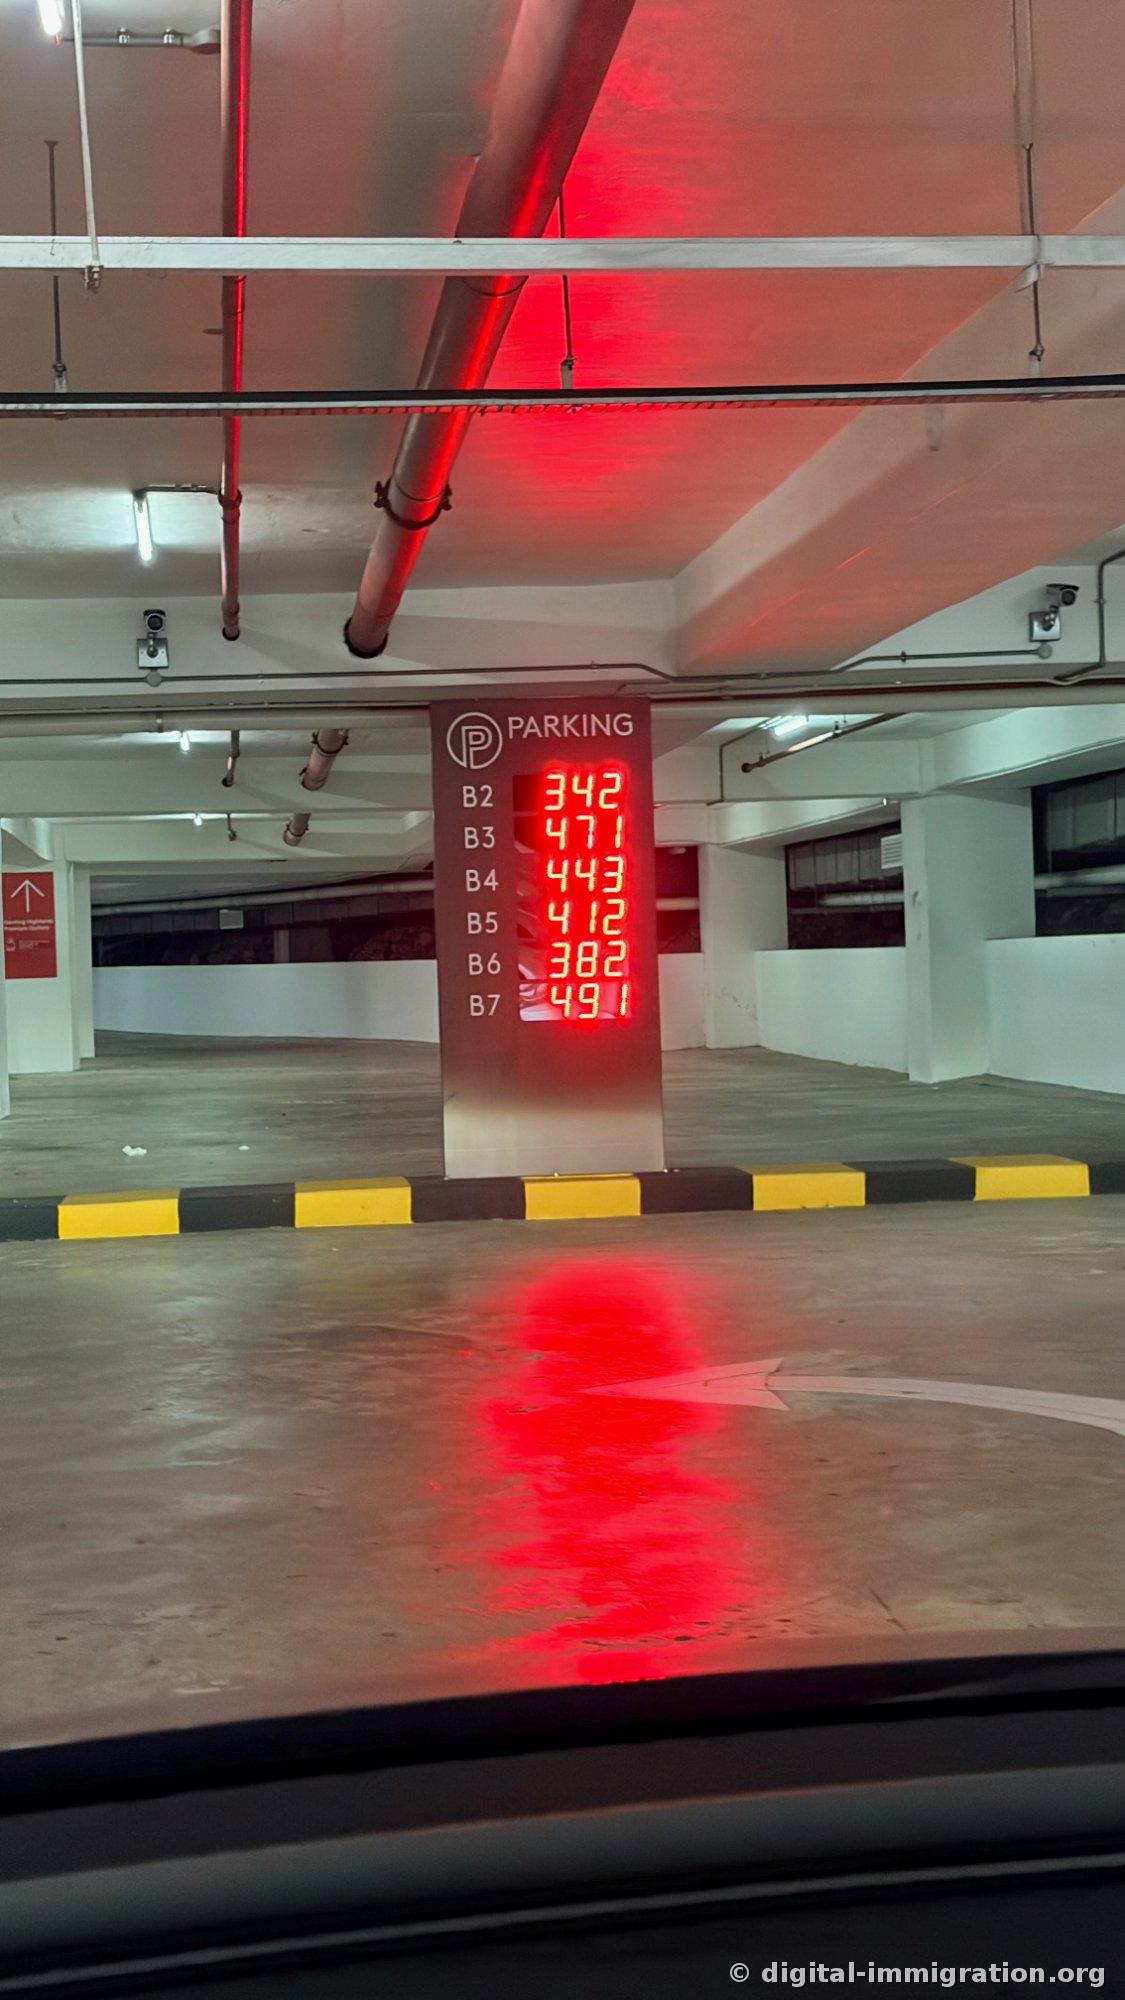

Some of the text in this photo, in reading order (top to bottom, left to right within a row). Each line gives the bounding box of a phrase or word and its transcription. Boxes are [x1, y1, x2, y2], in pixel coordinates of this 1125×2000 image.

[508, 713, 634, 739] PARKING
[462, 784, 494, 808] B2
[544, 772, 621, 811] 342
[463, 826, 496, 849] B3
[545, 814, 623, 850] 471
[465, 869, 499, 892] B4
[547, 856, 625, 893] 443
[467, 911, 499, 934] B5
[547, 898, 625, 935] 412
[468, 953, 501, 975] B6
[549, 940, 627, 979] 382
[469, 995, 501, 1016] B7
[551, 982, 629, 1019] 491
